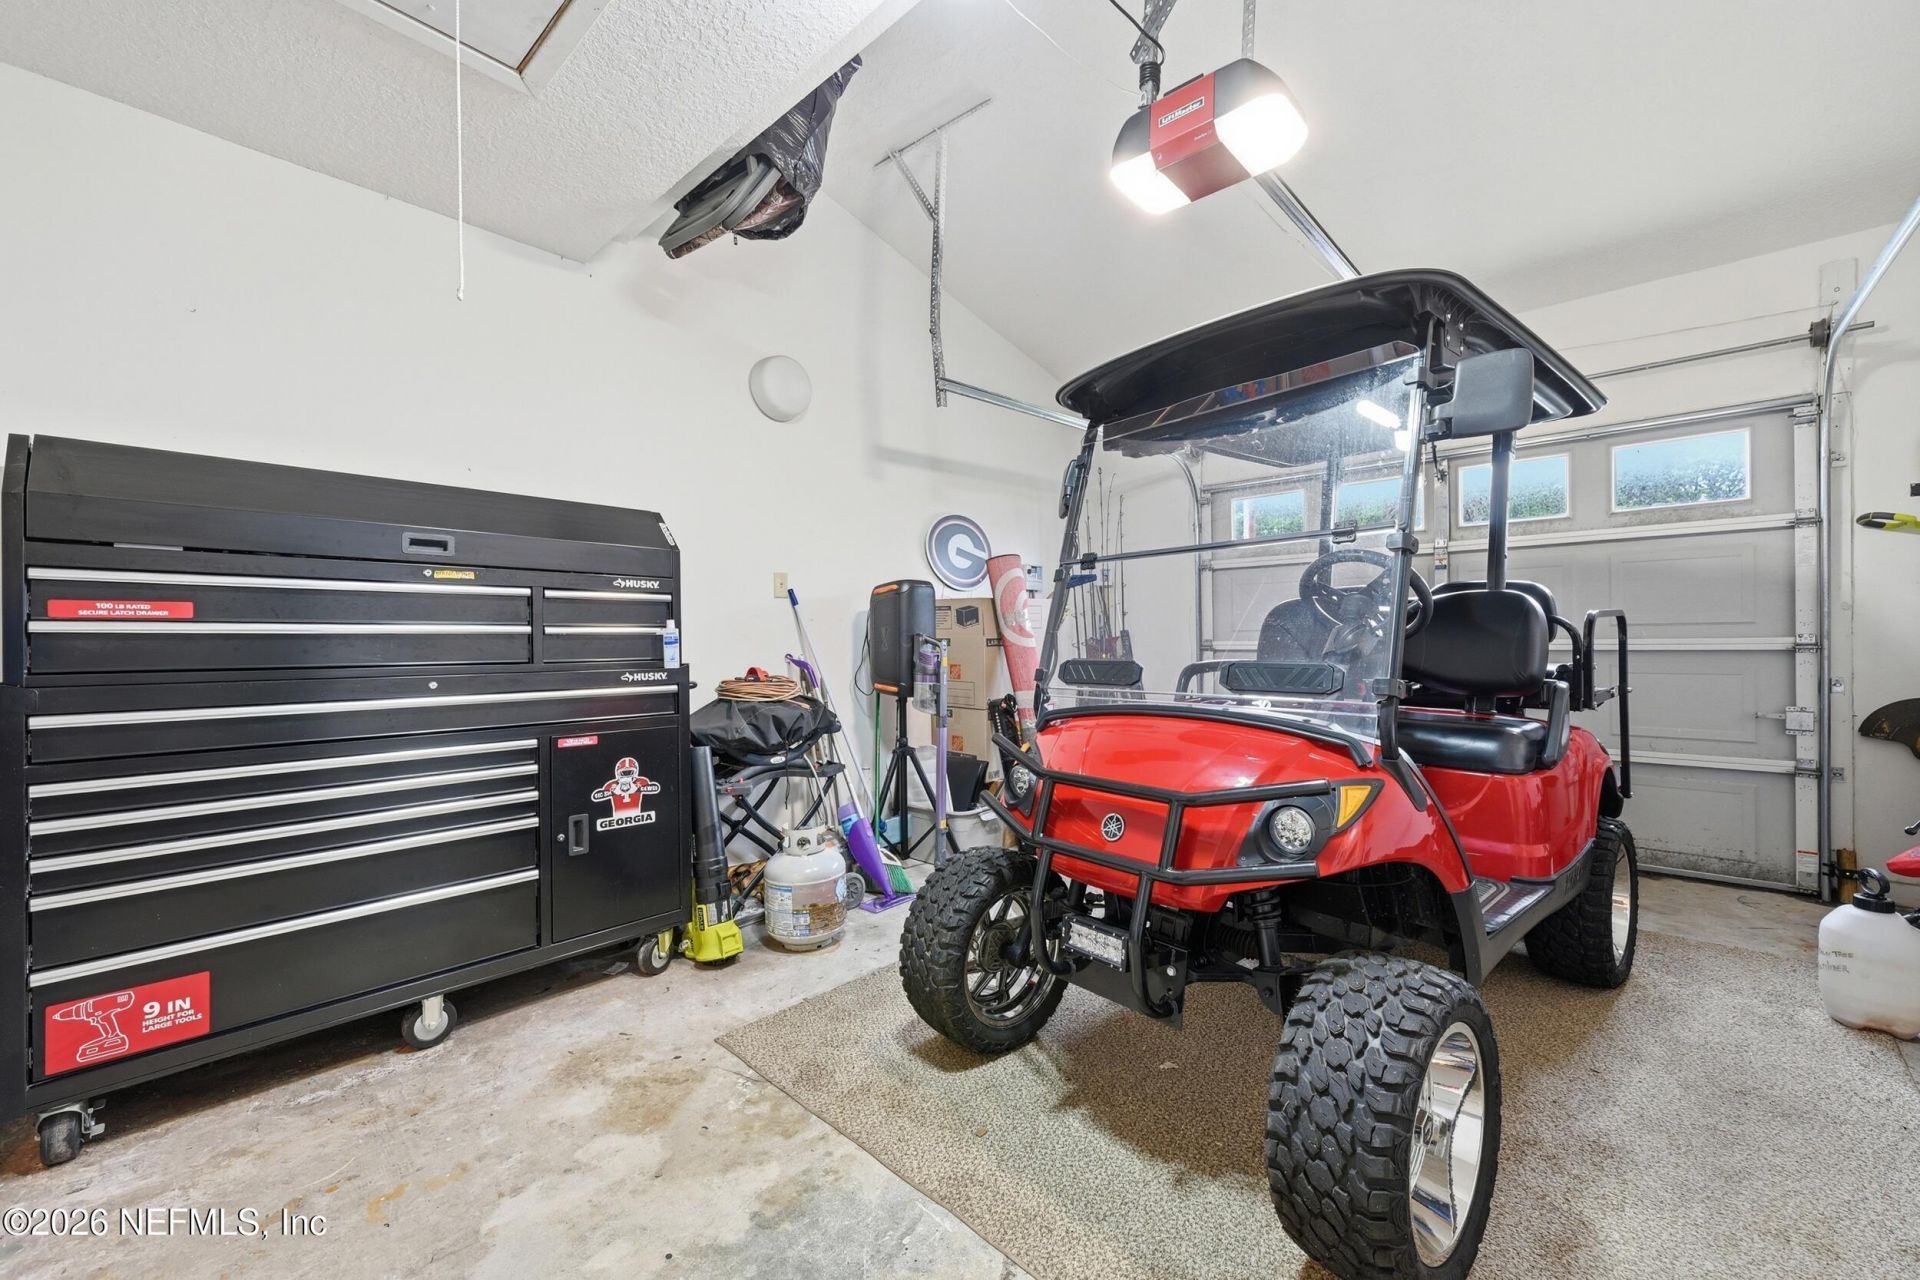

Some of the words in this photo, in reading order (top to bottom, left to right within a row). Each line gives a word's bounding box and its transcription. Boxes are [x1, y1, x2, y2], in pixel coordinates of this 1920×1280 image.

[626, 579, 660, 589] HUSKY
[95, 602, 113, 610] 100
[633, 672, 668, 682] HUSKY
[600, 813, 653, 829] GEORGIA
[143, 1001, 161, 1019] 9
[167, 996, 191, 1014] IN
[142, 1013, 176, 1027] HEIGHT
[177, 1009, 195, 1018] FOR
[142, 1021, 173, 1033] LARGE
[175, 1012, 203, 1025] TOOLS
